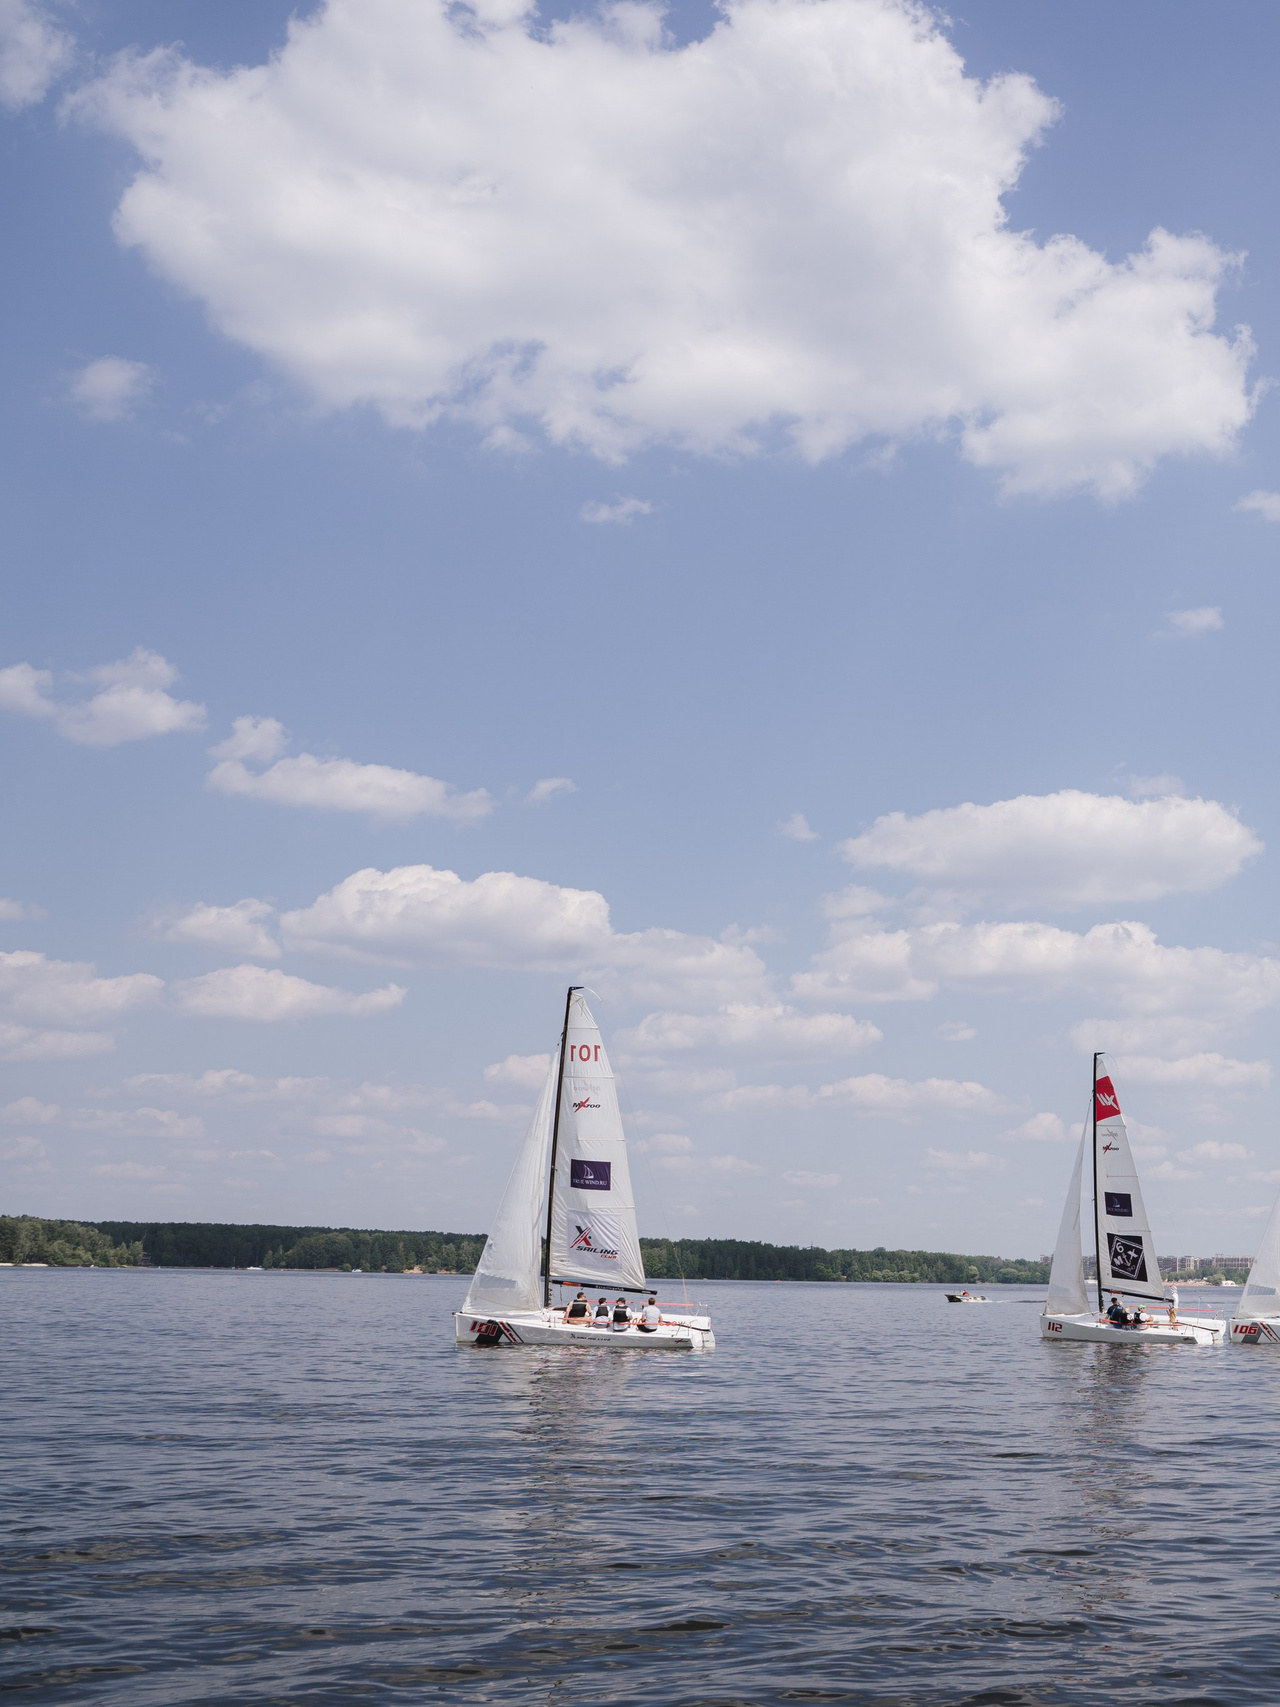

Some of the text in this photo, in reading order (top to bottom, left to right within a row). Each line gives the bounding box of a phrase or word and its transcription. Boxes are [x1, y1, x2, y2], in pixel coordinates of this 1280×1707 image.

[575, 1245, 620, 1256] SAILING
[1115, 1241, 1125, 1253] 6
[469, 1320, 498, 1336] 101
[1047, 1321, 1063, 1333] 112
[1233, 1324, 1259, 1335] 106
